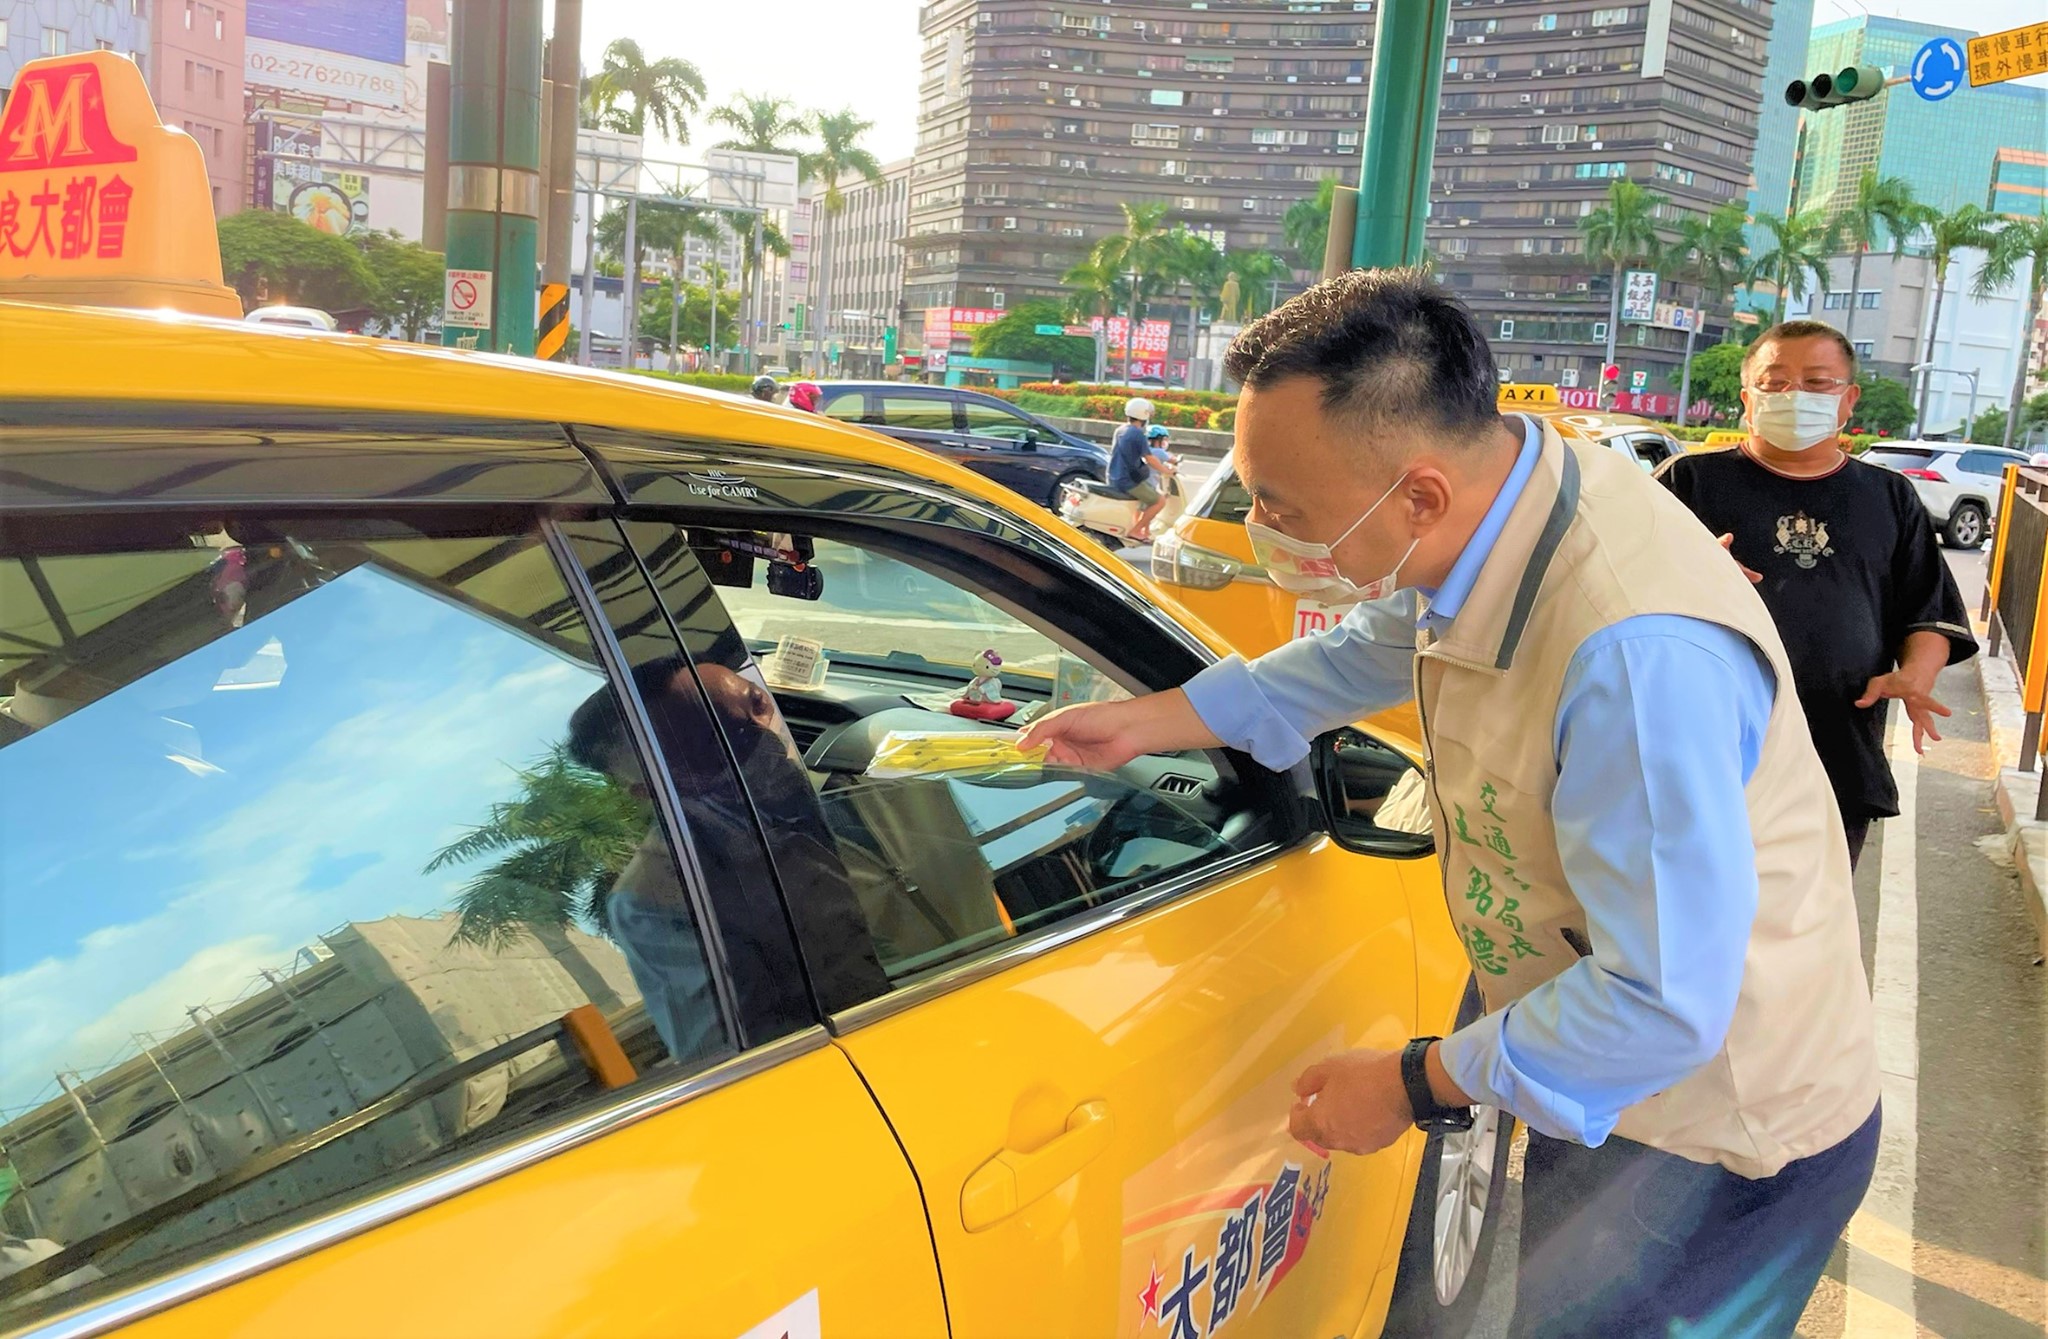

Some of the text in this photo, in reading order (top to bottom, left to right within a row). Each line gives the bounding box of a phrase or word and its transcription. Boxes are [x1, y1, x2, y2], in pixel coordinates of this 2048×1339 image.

[1503, 388, 1545, 400] AXI
[1559, 391, 1620, 410] HOTL
[688, 484, 759, 498] Use for CAMRY
[1297, 611, 1342, 638] TD
